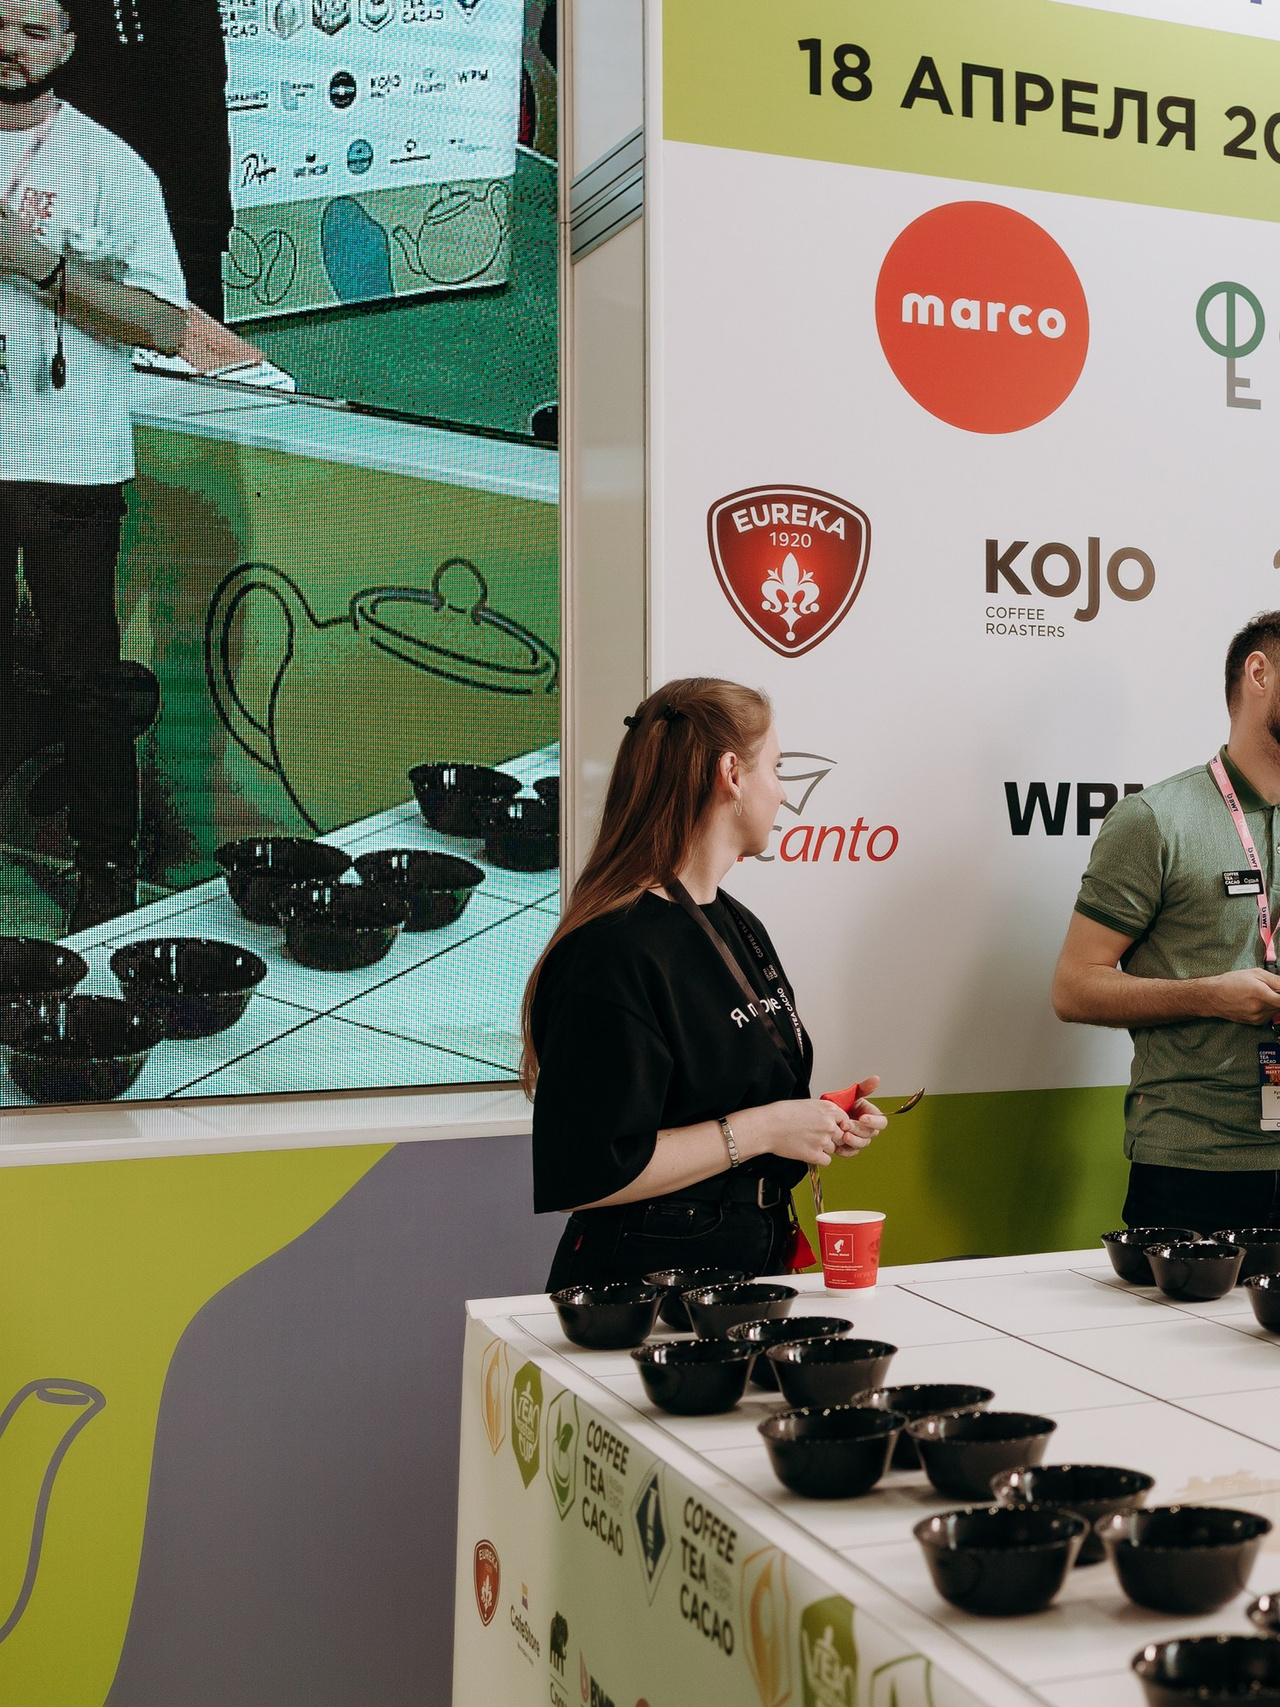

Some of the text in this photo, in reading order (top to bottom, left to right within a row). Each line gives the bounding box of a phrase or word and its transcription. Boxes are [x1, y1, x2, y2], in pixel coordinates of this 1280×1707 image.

[798, 37, 873, 102] 18
[900, 55, 1196, 151] АПРЕЛЯ
[901, 292, 1067, 339] marco
[731, 503, 846, 541] EUREKA
[769, 531, 812, 549] 1920
[985, 536, 1155, 623] KOJO
[985, 606, 1045, 621] COFFEE
[985, 622, 1065, 639] ROASTERS
[1004, 782, 1144, 836] WP
[586, 1419, 630, 1475] COFFEE
[583, 1454, 606, 1500] TEA
[582, 1496, 624, 1557] CACAO
[683, 1496, 737, 1565] COFFEE
[680, 1536, 708, 1591] TEA
[679, 1583, 735, 1657] CACAO
